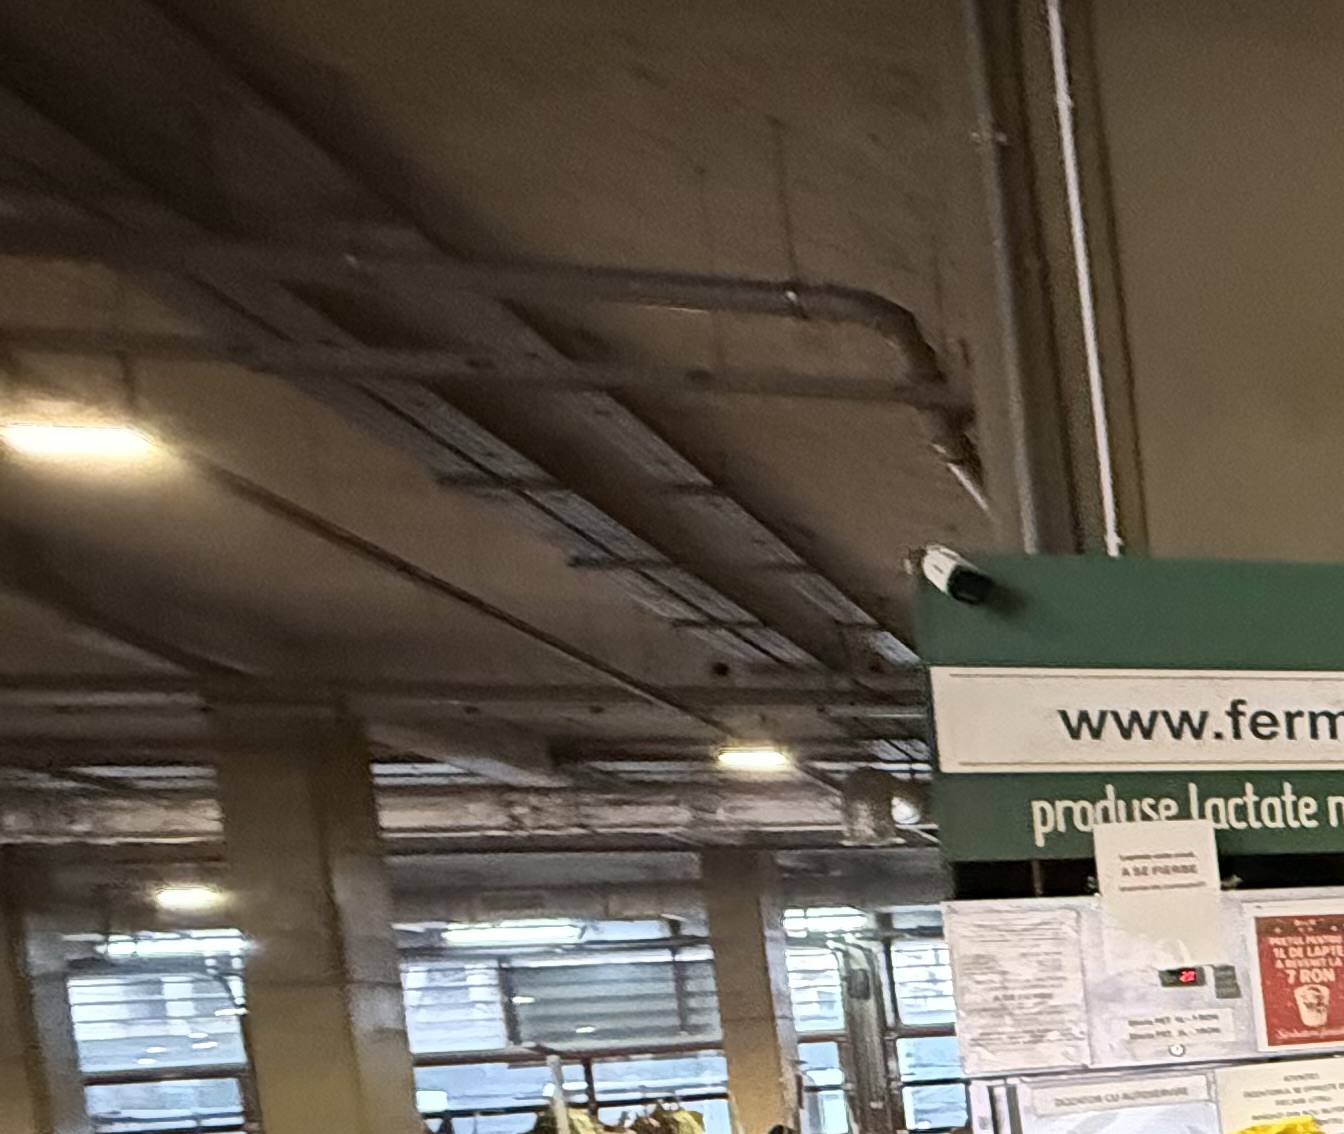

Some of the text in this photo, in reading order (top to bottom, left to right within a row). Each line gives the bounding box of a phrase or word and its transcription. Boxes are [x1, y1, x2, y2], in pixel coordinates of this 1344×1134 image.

[1031, 782, 1179, 848] produse
[1188, 780, 1319, 830] lactate
[1284, 967, 1337, 984] 7 RON
